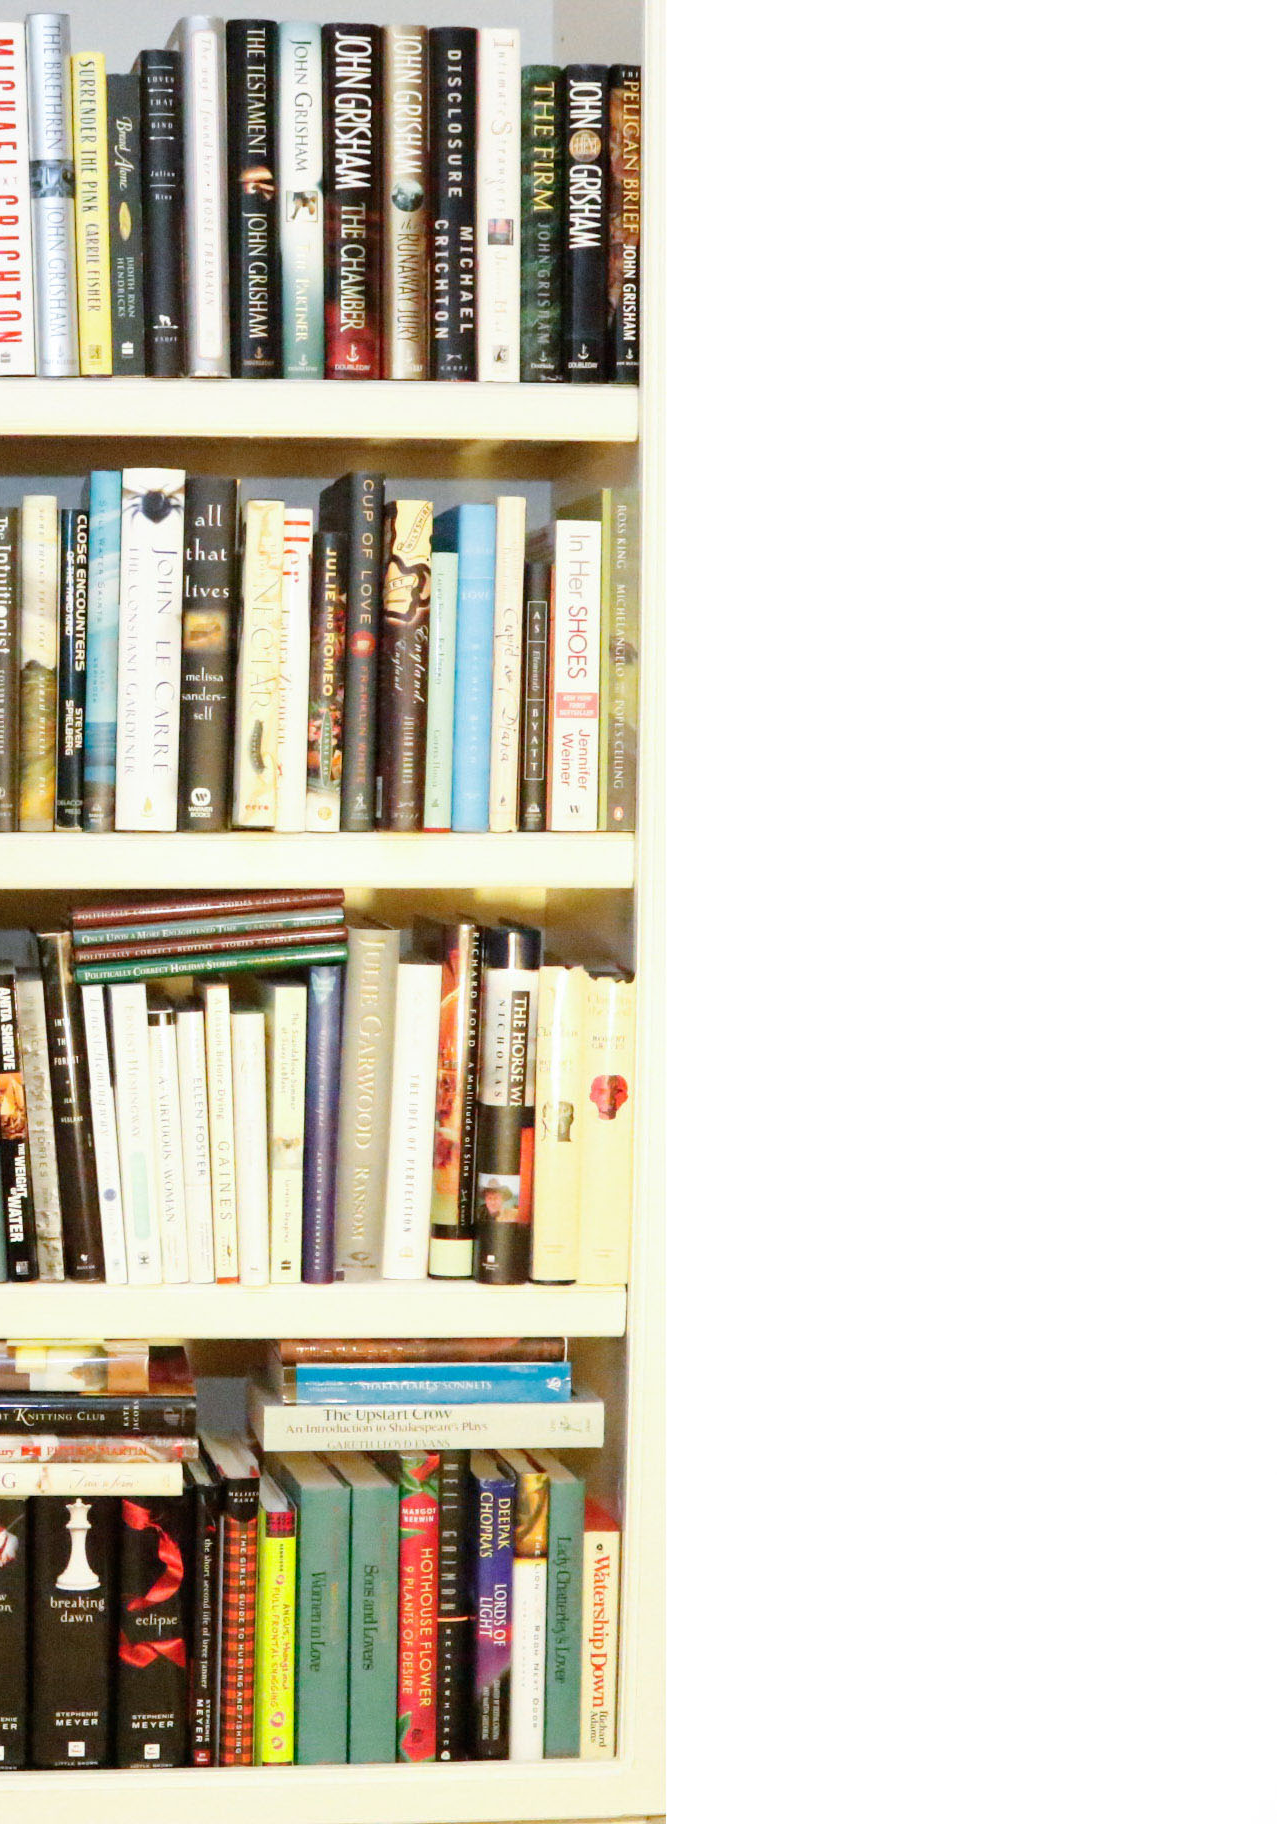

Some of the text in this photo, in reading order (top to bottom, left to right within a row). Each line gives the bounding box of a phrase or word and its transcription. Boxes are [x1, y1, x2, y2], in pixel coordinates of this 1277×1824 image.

[42, 24, 63, 150] THE BRETHREN
[245, 27, 267, 157] THE TESTAMENT
[289, 39, 313, 172] JOHN GRISHAM
[334, 30, 373, 190] JOHN GRISHAM
[392, 34, 423, 174] JOHN GRISHAM
[569, 80, 602, 129] JOHN
[79, 59, 99, 213] SURRENDER THE PINK
[151, 122, 174, 130] BIND
[447, 49, 463, 198] DISCLOSURE
[533, 82, 555, 212] THE FIRM
[622, 80, 640, 171] PELICAN
[242, 211, 267, 256] JOHN
[569, 164, 602, 249] GRISHAM
[622, 178, 640, 235] BRIEF
[340, 201, 366, 332] THE CHAMBER
[434, 219, 449, 339] CRICHTON
[459, 225, 473, 335] MICHAEL
[622, 243, 637, 341] JOHN GRISHAM
[247, 260, 270, 339] GRISHAM
[194, 505, 222, 528] all
[186, 538, 228, 562] that
[360, 479, 375, 626] CUP OF LOVE
[75, 514, 88, 672] CLOSE ENCOUNTERS
[185, 576, 230, 599] lives
[566, 533, 588, 681] In Her SHOES
[322, 547, 337, 698] JULIE AND ROMEO
[185, 671, 224, 682] melissa
[65, 699, 74, 756] SPIELBERG
[75, 707, 83, 748] STEVEN
[193, 706, 213, 721] self
[560, 732, 574, 787] Weiner
[577, 728, 591, 791] Jennifer
[468, 931, 479, 1048] RICHARD FORD
[513, 997, 528, 1021] THE
[0, 1025, 16, 1071] SHREVE
[494, 999, 506, 1098] NICHOLAS
[510, 1022, 526, 1086] HORSE
[354, 1015, 382, 1151] GARWOOD
[194, 1077, 206, 1177] ELLEN FOSTER
[323, 1408, 453, 1423] The Upstart Crow
[480, 1492, 493, 1559] CHOPRA'S
[497, 1498, 511, 1550] DEEPAK
[50, 1596, 105, 1612] breaking
[60, 1611, 93, 1623] dawn
[135, 1615, 178, 1636] eclipse
[362, 1563, 379, 1671] Sons and Lovers
[404, 1577, 414, 1626] PLANTS
[419, 1548, 433, 1707] HOTHOUSE FLOWER
[479, 1597, 493, 1637] LIGHT
[494, 1583, 507, 1647] LORDS OF
[589, 1555, 611, 1708] Watership Down
[403, 1630, 412, 1647] OF
[402, 1650, 413, 1695] DESIRE
[55, 1718, 99, 1726] MEYER
[131, 1720, 174, 1728] MEYER
[195, 1699, 203, 1744] MEYER
[598, 1711, 608, 1747] Richard
